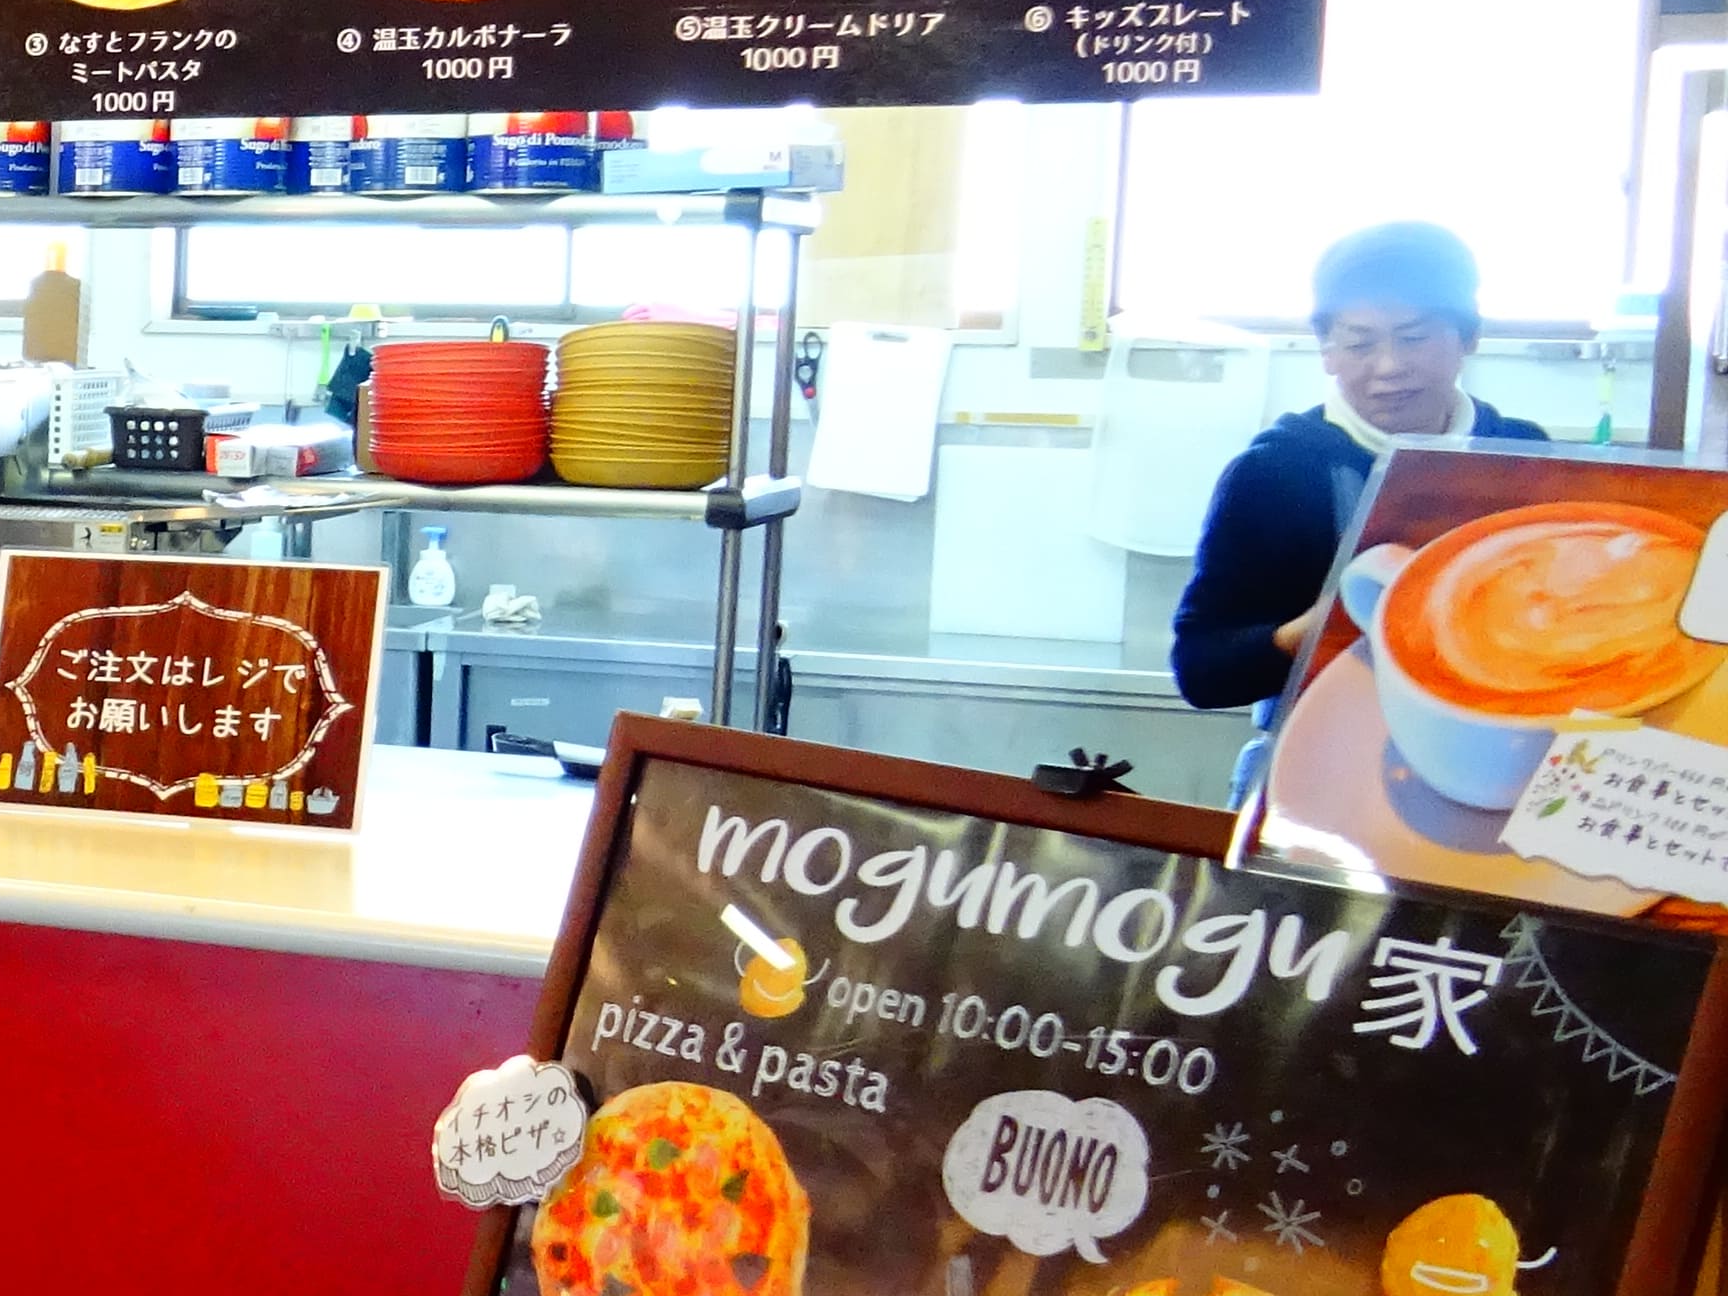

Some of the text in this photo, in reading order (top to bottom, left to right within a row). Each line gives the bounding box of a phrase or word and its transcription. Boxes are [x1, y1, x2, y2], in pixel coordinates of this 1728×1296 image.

[58, 28, 237, 55] なすとフランクの
[372, 23, 575, 53] 温玉カルボナーラ
[70, 58, 202, 83] ミートパスタ
[493, 134, 527, 153] Sugo
[56, 647, 306, 694] ご注文はレジで
[67, 696, 282, 742] お願いします
[697, 804, 1503, 1056] mogumogu 家
[592, 993, 889, 1115] pizza & pasta
[826, 975, 1217, 1097] open 10:00-15:00
[448, 1086, 567, 1134] イチオシの
[979, 1113, 1118, 1214] BUONO
